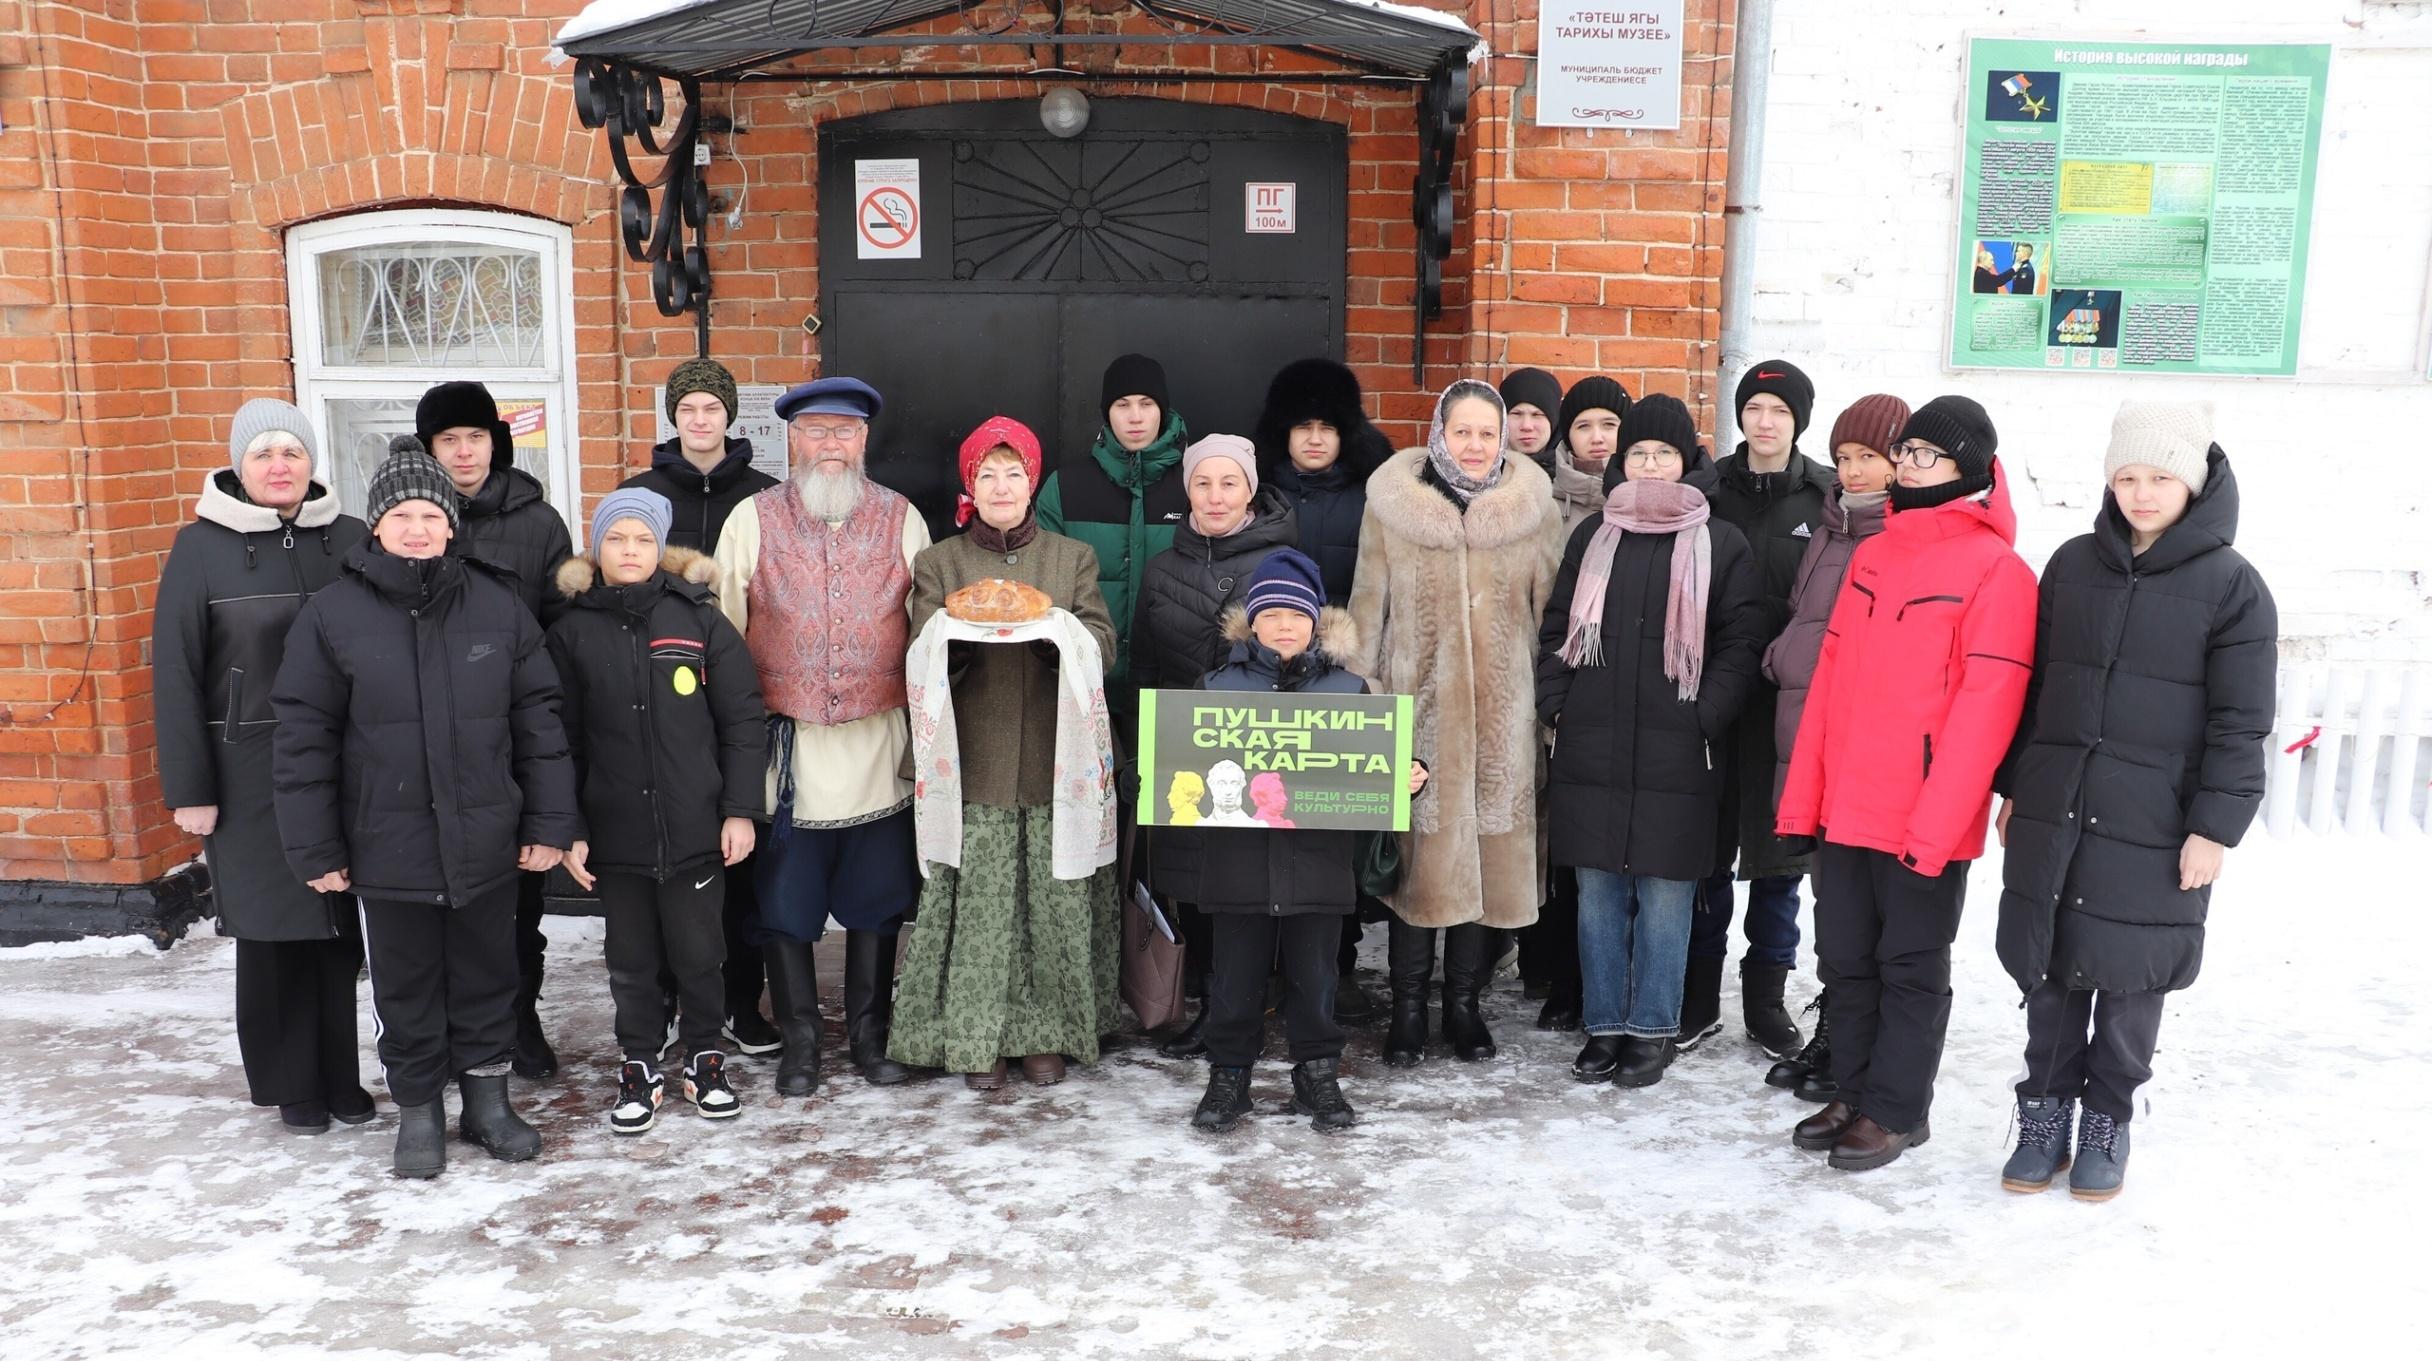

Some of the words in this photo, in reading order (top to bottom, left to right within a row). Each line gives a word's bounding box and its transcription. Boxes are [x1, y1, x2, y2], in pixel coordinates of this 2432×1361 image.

[1569, 12, 1625, 24] «ТӘТЕШ
[1629, 13, 1660, 25] ЯГЫ
[1556, 27, 1614, 39] ТАРИХЫ
[1618, 28, 1671, 40] МУЗЕЕ»
[2054, 48, 2113, 64] История
[2116, 50, 2181, 66] высокой
[2184, 53, 2249, 67] награды
[1561, 65, 1622, 74] МУНИЦИПАЛЬ
[1624, 67, 1663, 75] БЮДЖЕТ
[1576, 76, 1647, 84] УЧРЕЖДЕНИЕСЕ
[1257, 188, 1284, 206] ПГ
[739, 425, 746, 436] 8
[758, 425, 771, 436] 17
[1193, 707, 1393, 732] ПУШКИН
[1192, 728, 1312, 750] СКАЯ
[1244, 750, 1392, 774] КАРТА
[1294, 791, 1341, 802] ВЕДИ
[1345, 791, 1390, 803] СЕБЯ
[1294, 803, 1389, 815] КУЛЬТУРНО
